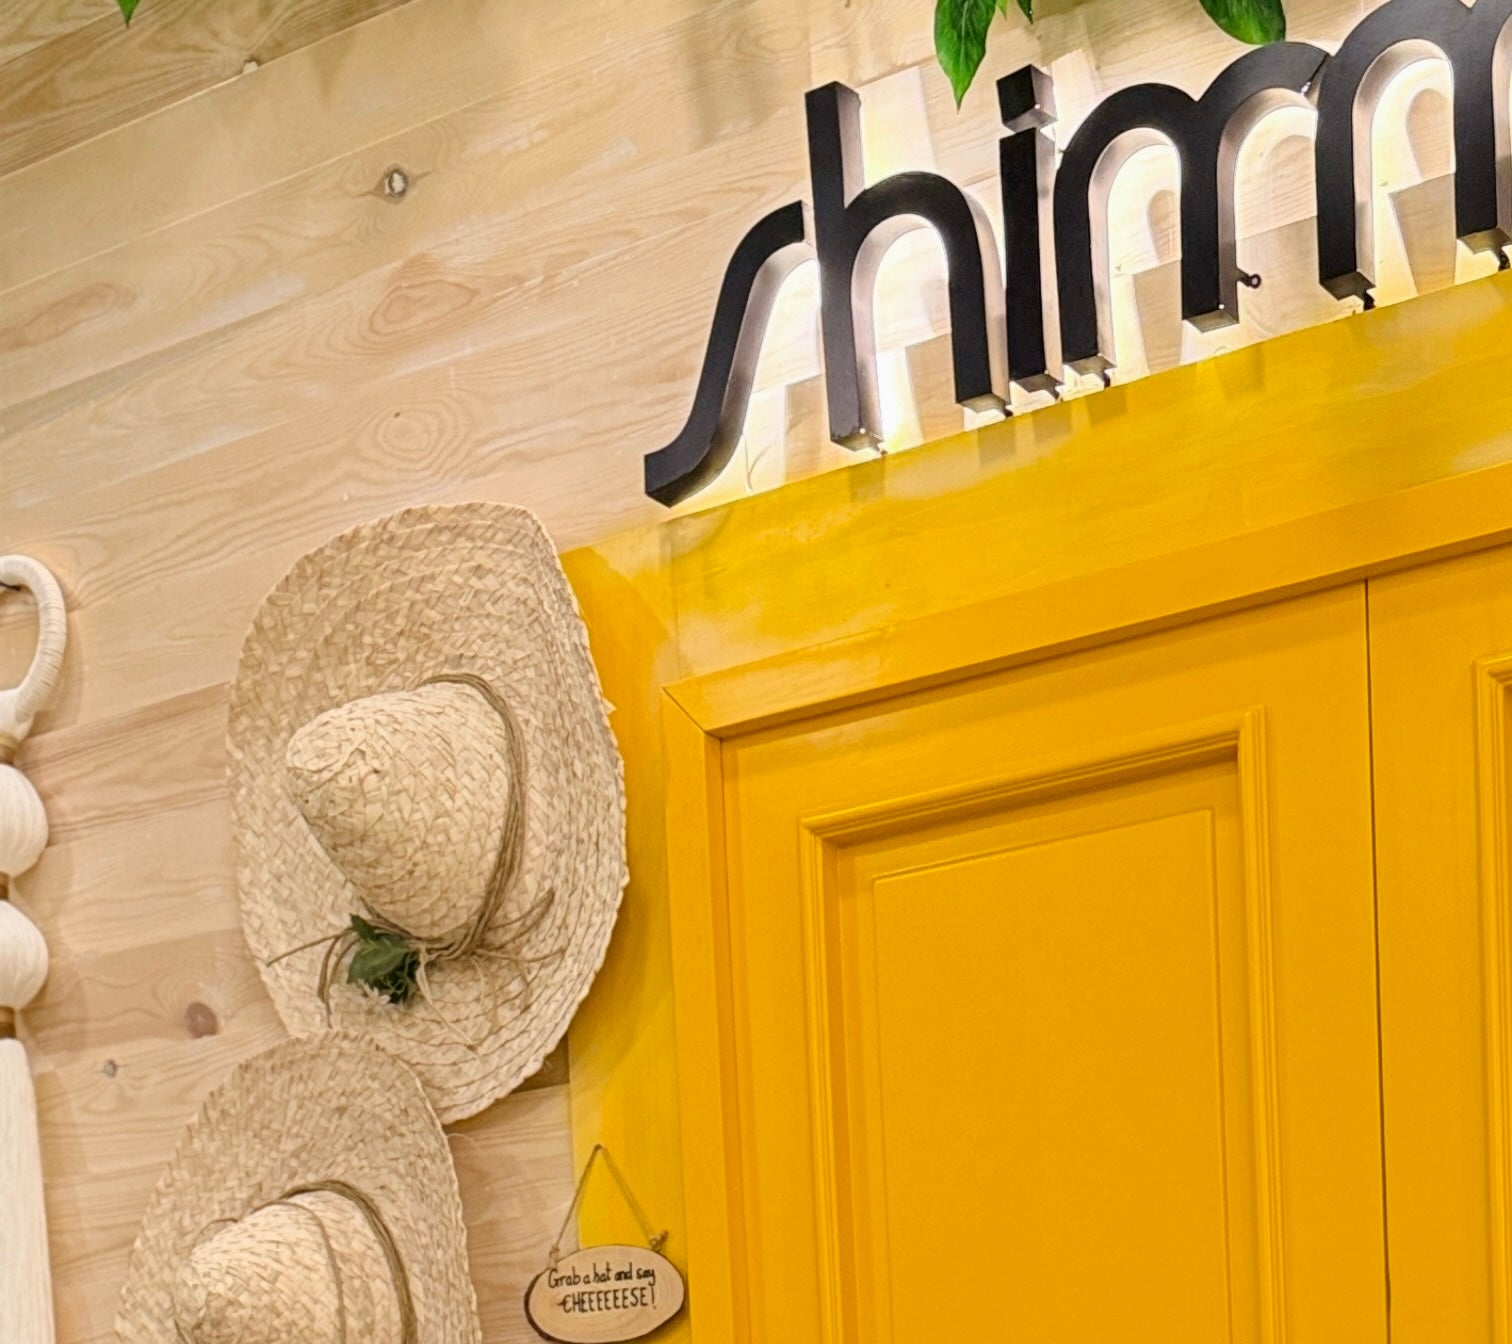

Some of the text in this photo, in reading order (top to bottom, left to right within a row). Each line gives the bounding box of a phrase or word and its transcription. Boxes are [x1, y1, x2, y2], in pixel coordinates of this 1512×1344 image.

[548, 1261, 656, 1288] Grab a hat and say
